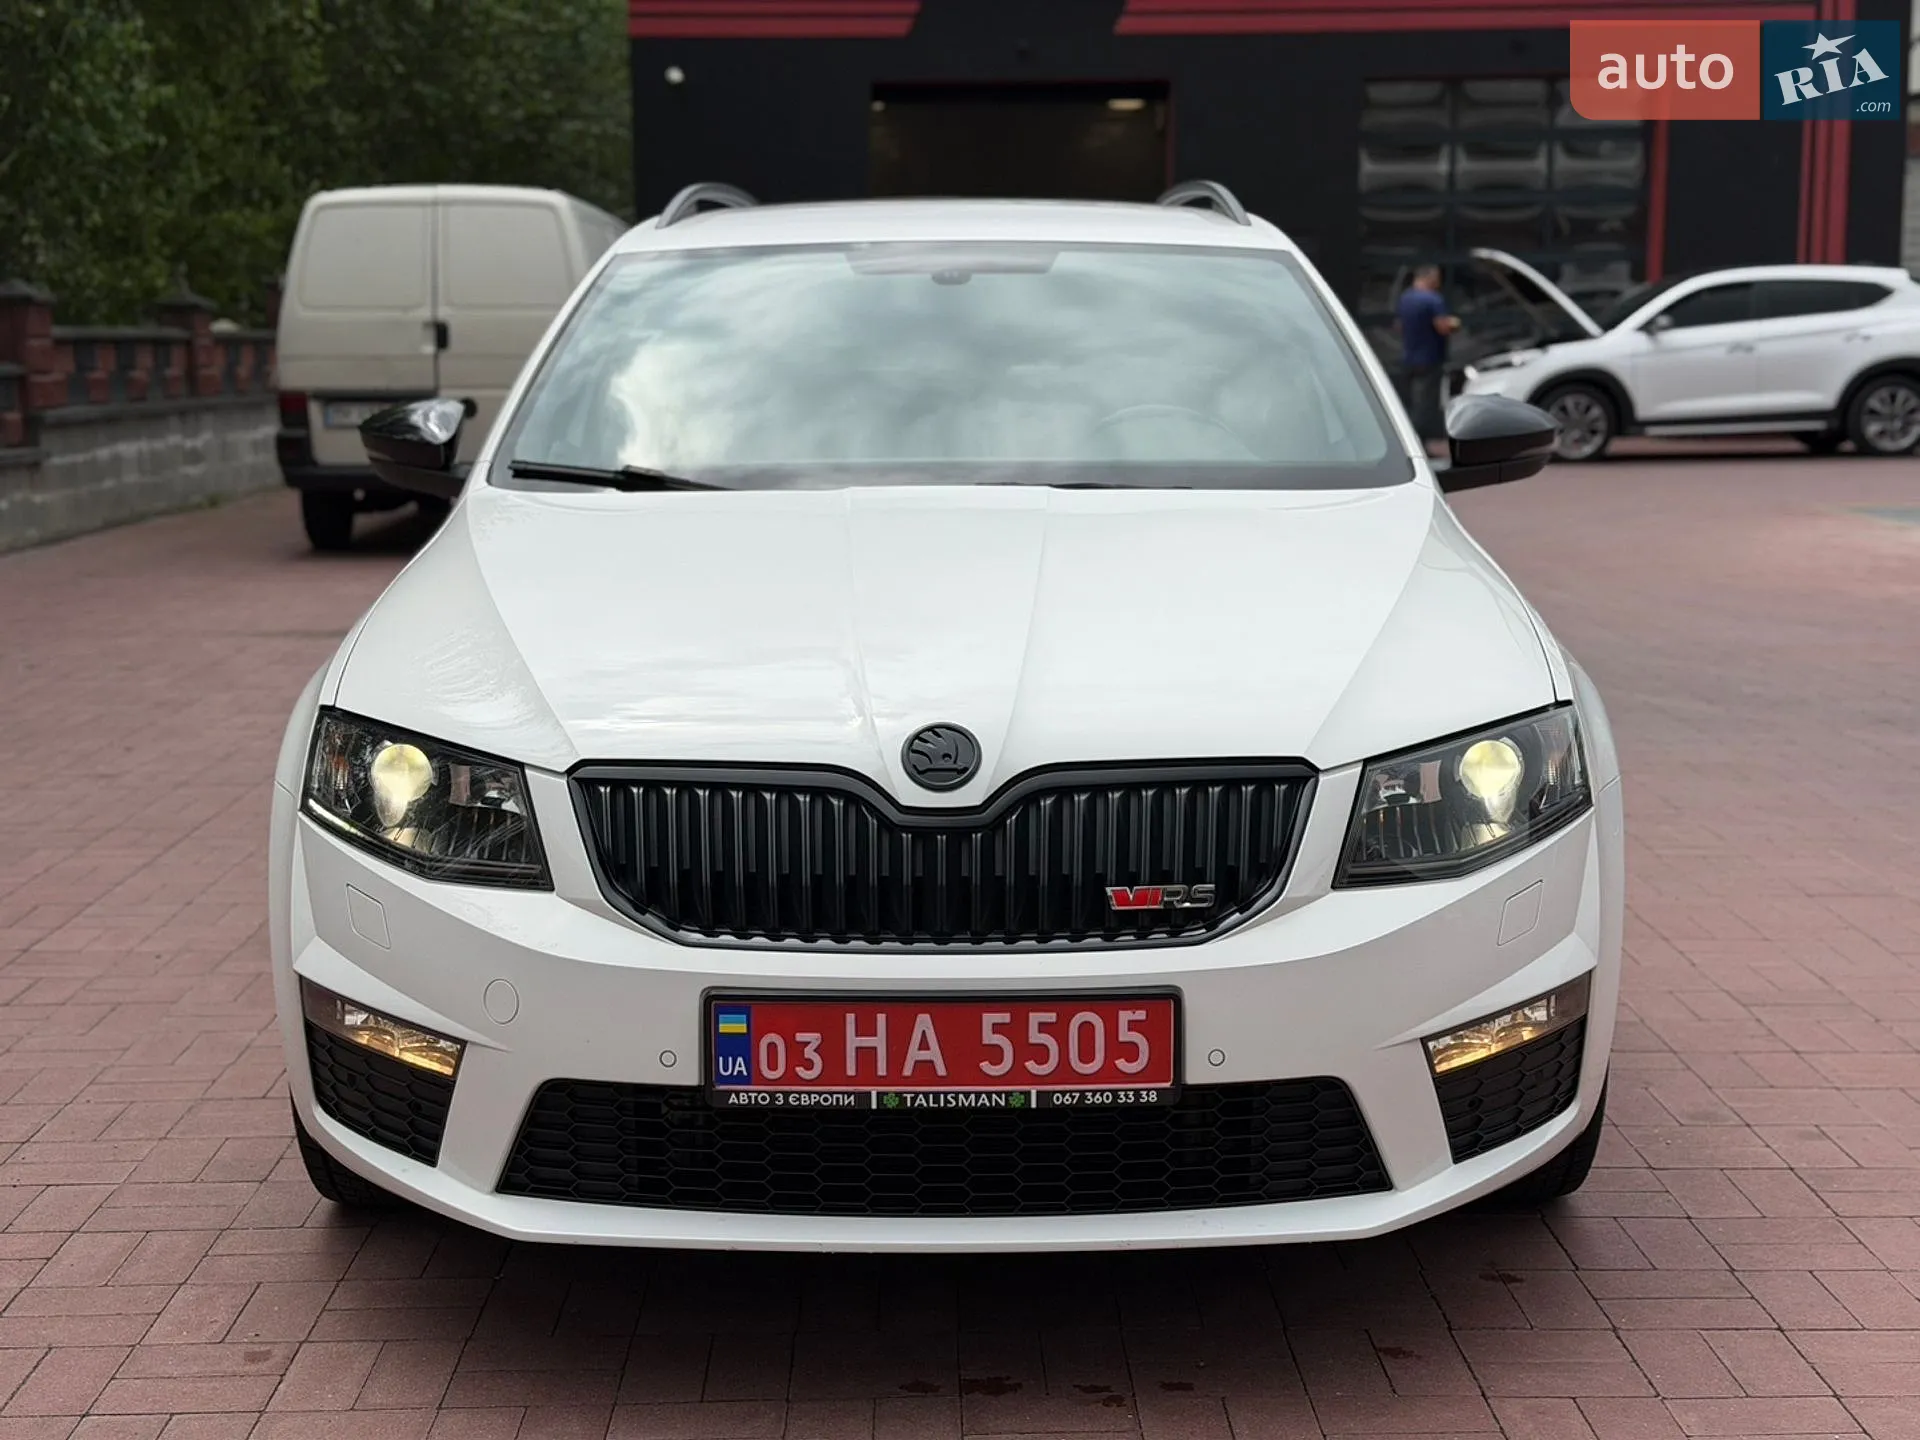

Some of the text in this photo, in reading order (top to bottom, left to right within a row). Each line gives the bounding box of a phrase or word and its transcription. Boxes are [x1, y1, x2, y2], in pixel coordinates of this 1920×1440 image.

[758, 1032, 823, 1081] 03
[979, 1009, 1151, 1076] 5505
[718, 1056, 748, 1077] UA
[728, 1091, 771, 1107] АВТО
[788, 1090, 856, 1107] ЄВРОПИ
[902, 1092, 1007, 1108] TALISMAN
[1052, 1090, 1159, 1106] 067 360 33 38
